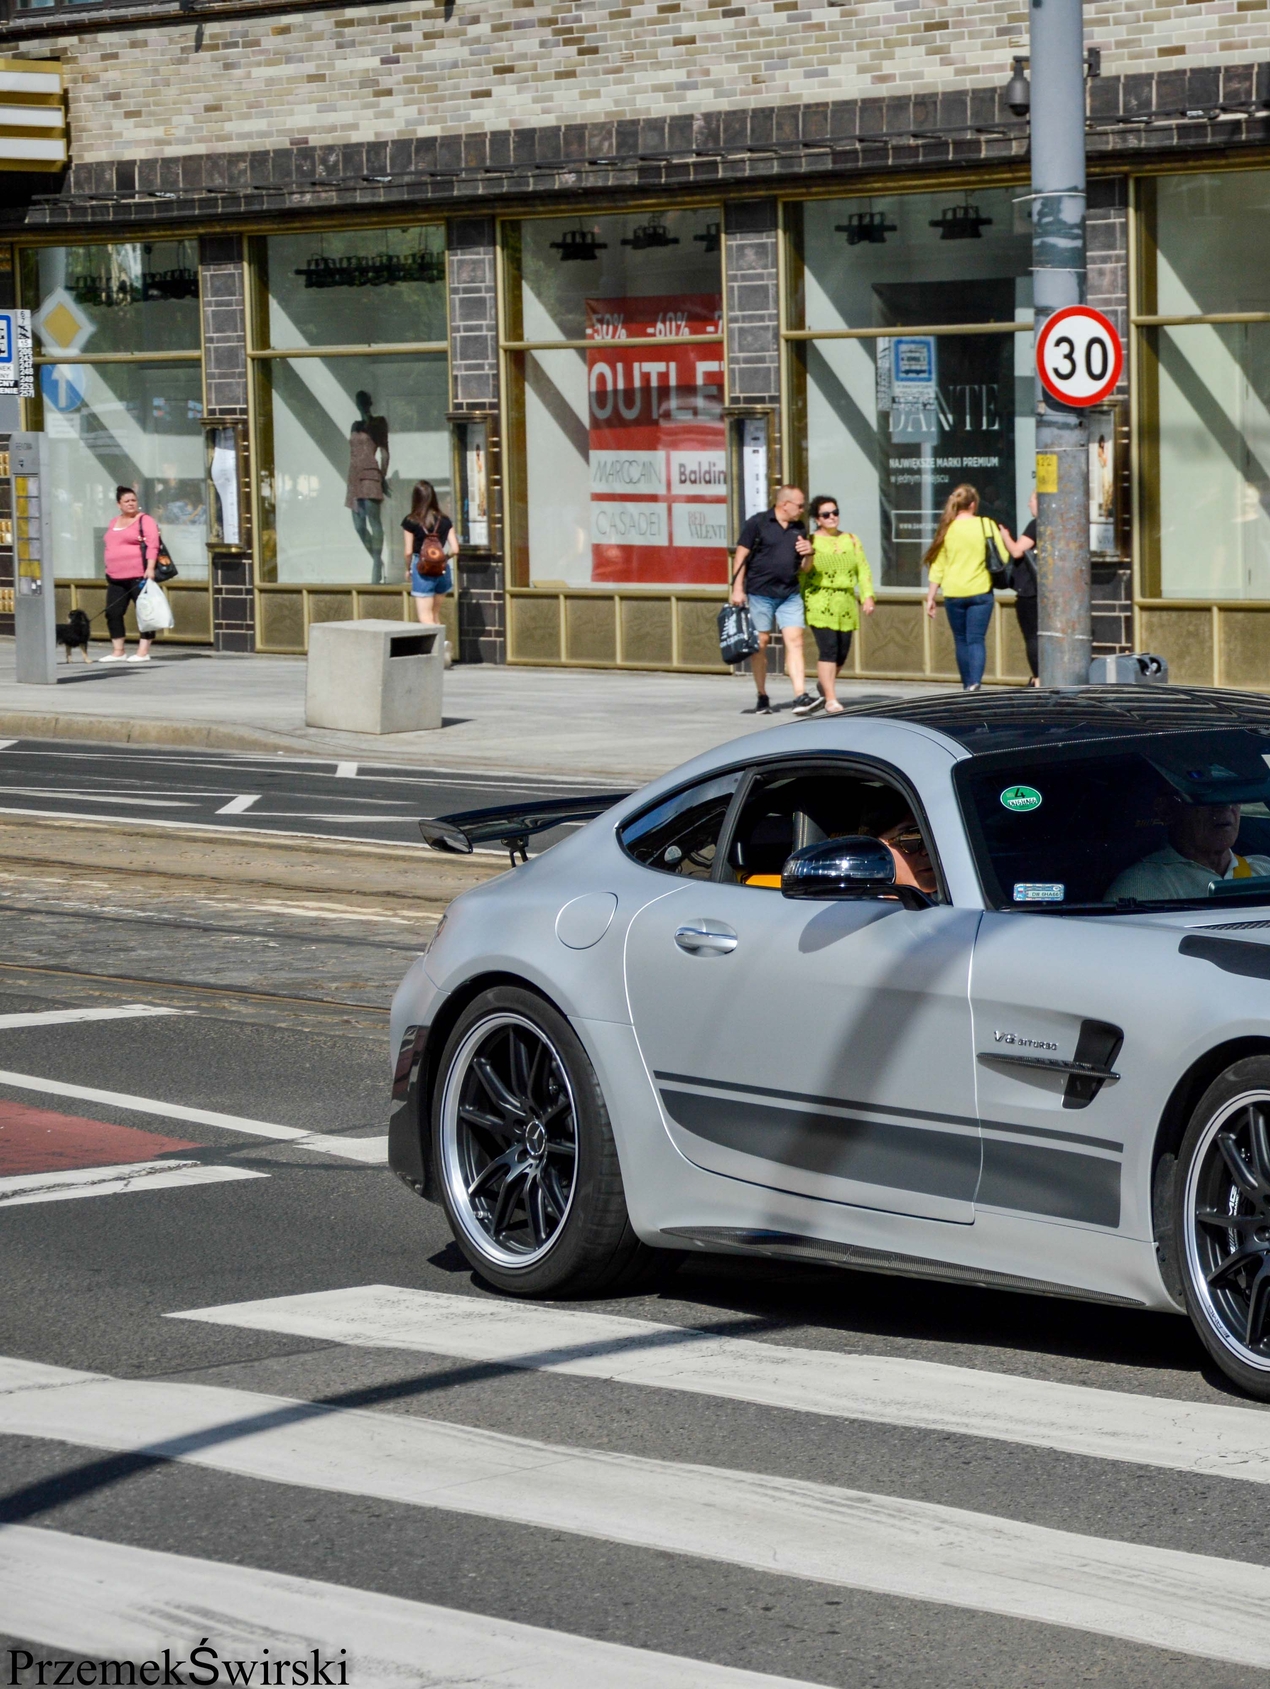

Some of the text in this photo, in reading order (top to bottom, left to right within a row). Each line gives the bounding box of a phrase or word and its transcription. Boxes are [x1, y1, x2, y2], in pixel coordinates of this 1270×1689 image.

[586, 310, 724, 340] -50% -60% -7
[1052, 336, 1108, 381] 30
[589, 361, 724, 420] OUTLE
[889, 384, 999, 432] DANTE
[678, 463, 727, 485] Baldin
[936, 457, 961, 468] MARKI
[963, 456, 999, 468] PREMIUM
[595, 511, 661, 536] CASADEI
[688, 524, 728, 540] VALENTI
[994, 1030, 1058, 1051] V8 BITURBO
